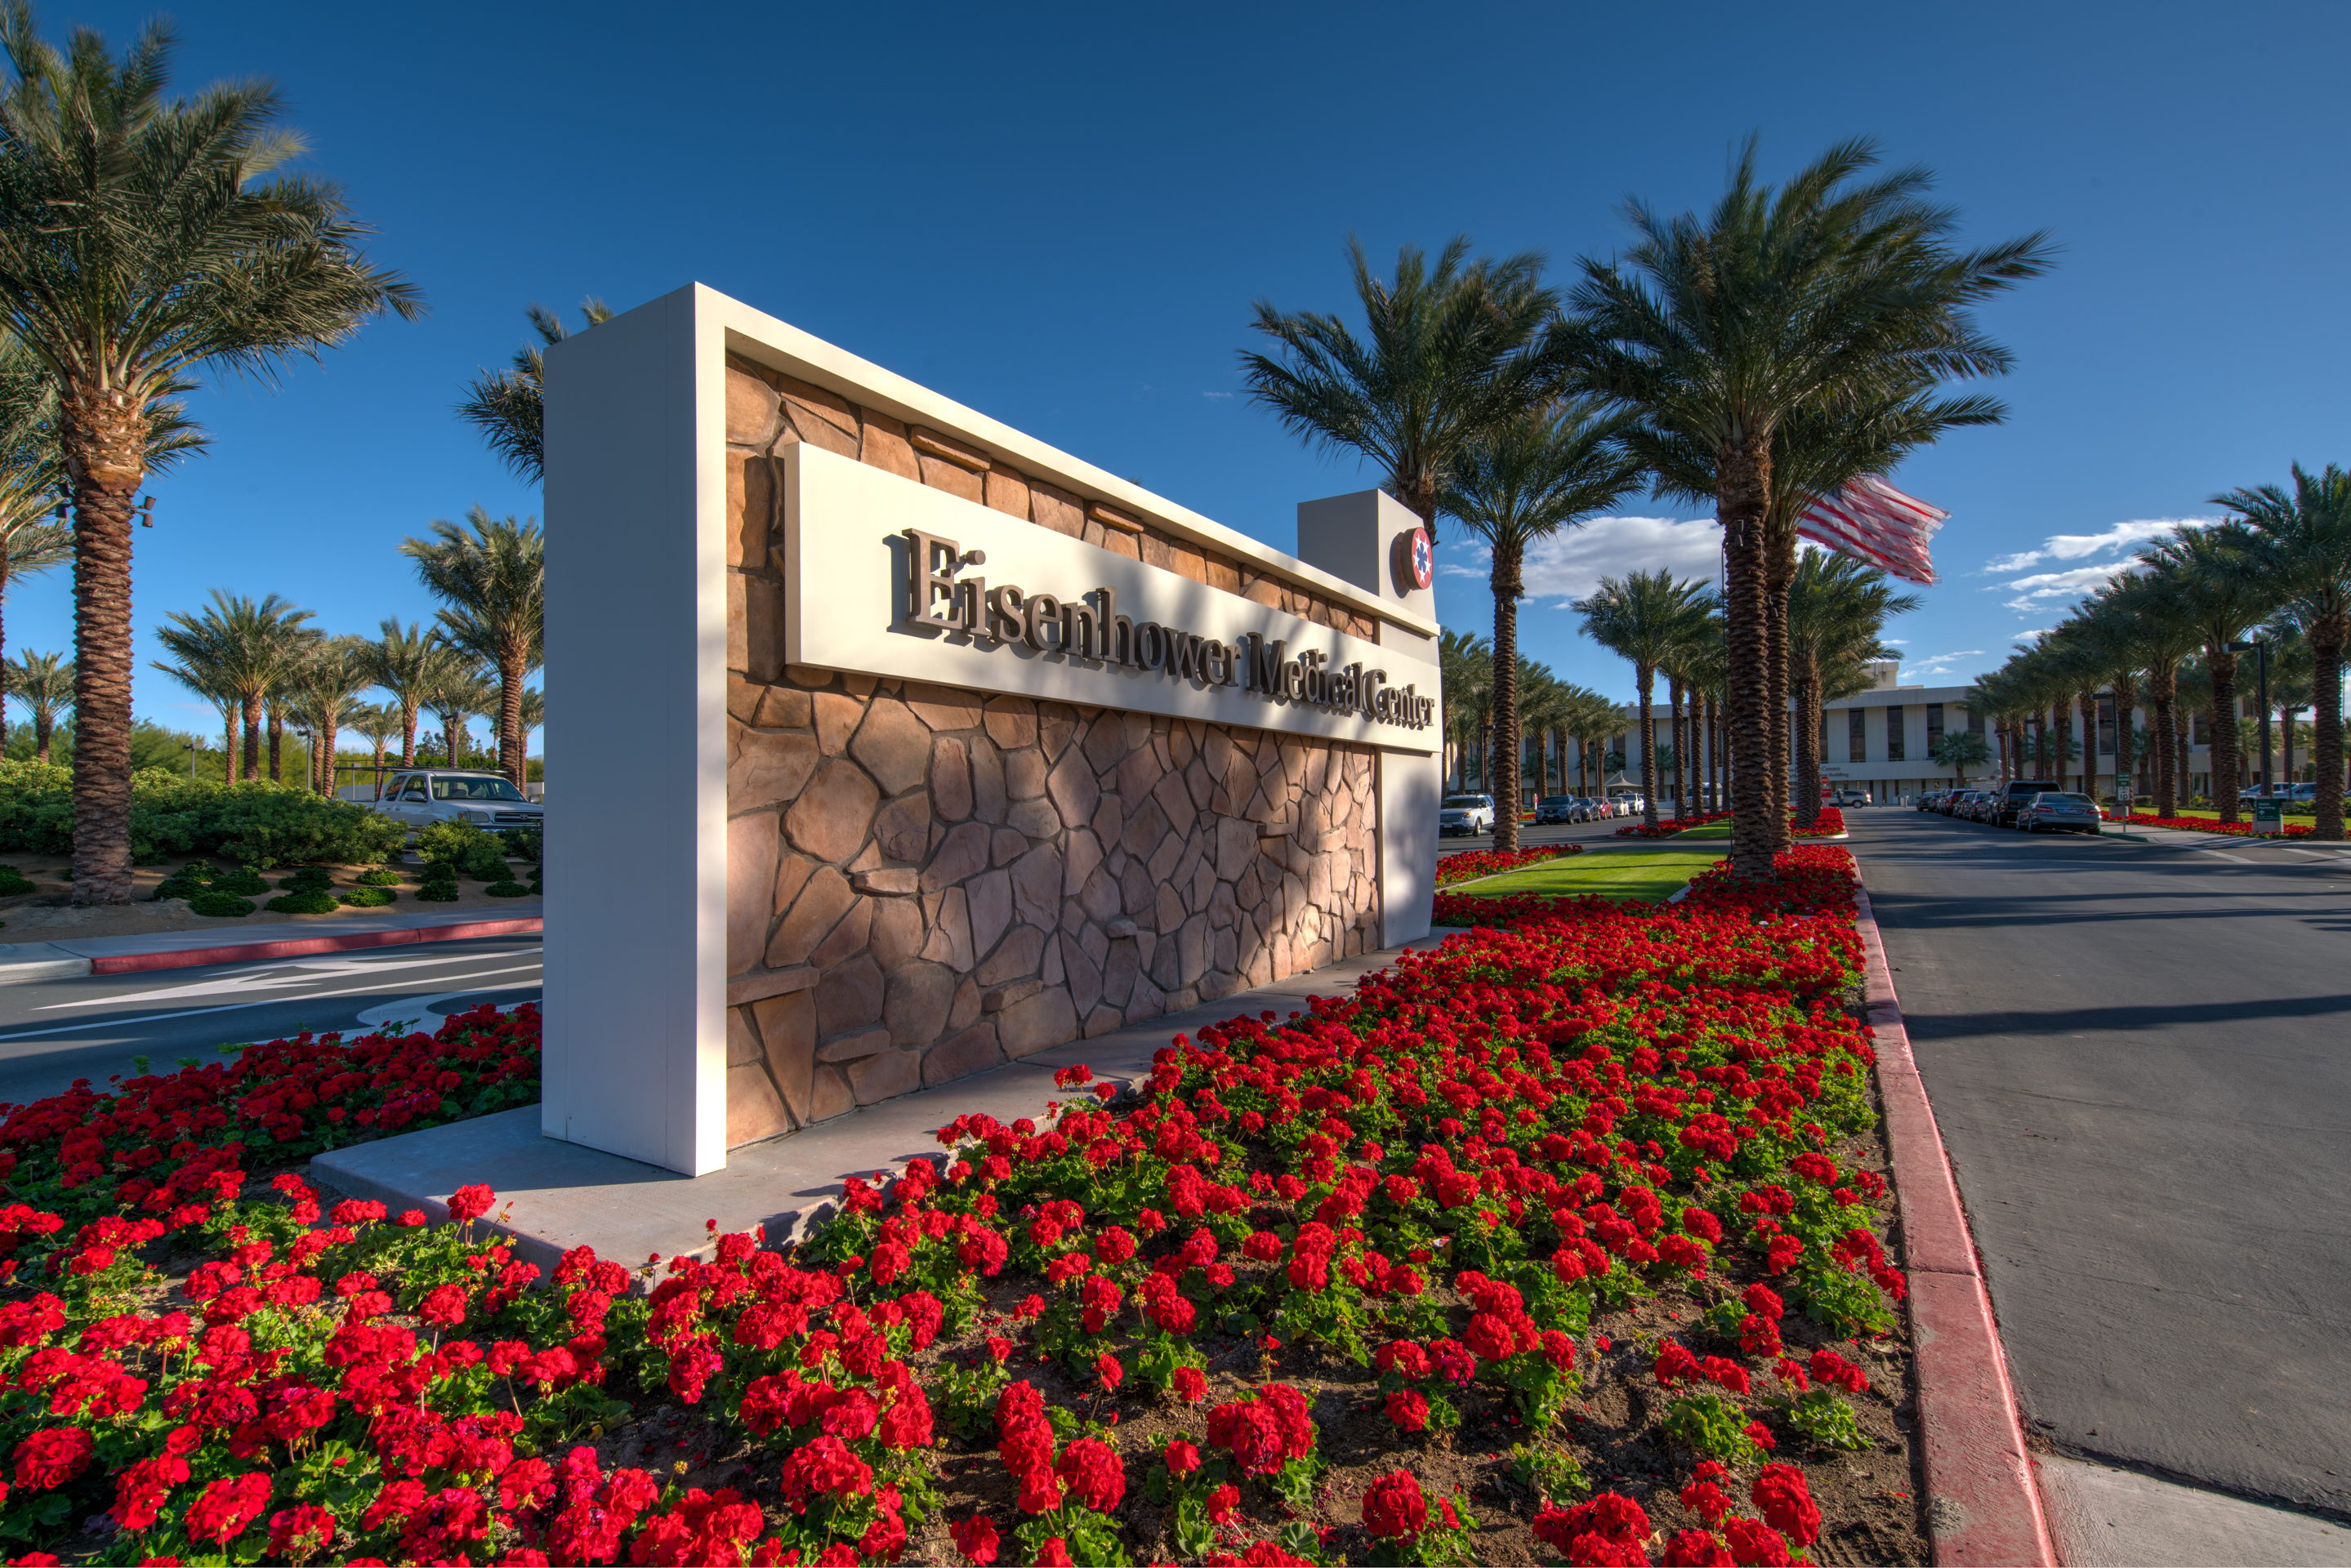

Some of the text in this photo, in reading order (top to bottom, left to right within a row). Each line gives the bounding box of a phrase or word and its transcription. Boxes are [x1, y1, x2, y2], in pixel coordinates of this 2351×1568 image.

[902, 528, 1435, 726] Eisenhower Medical Center
